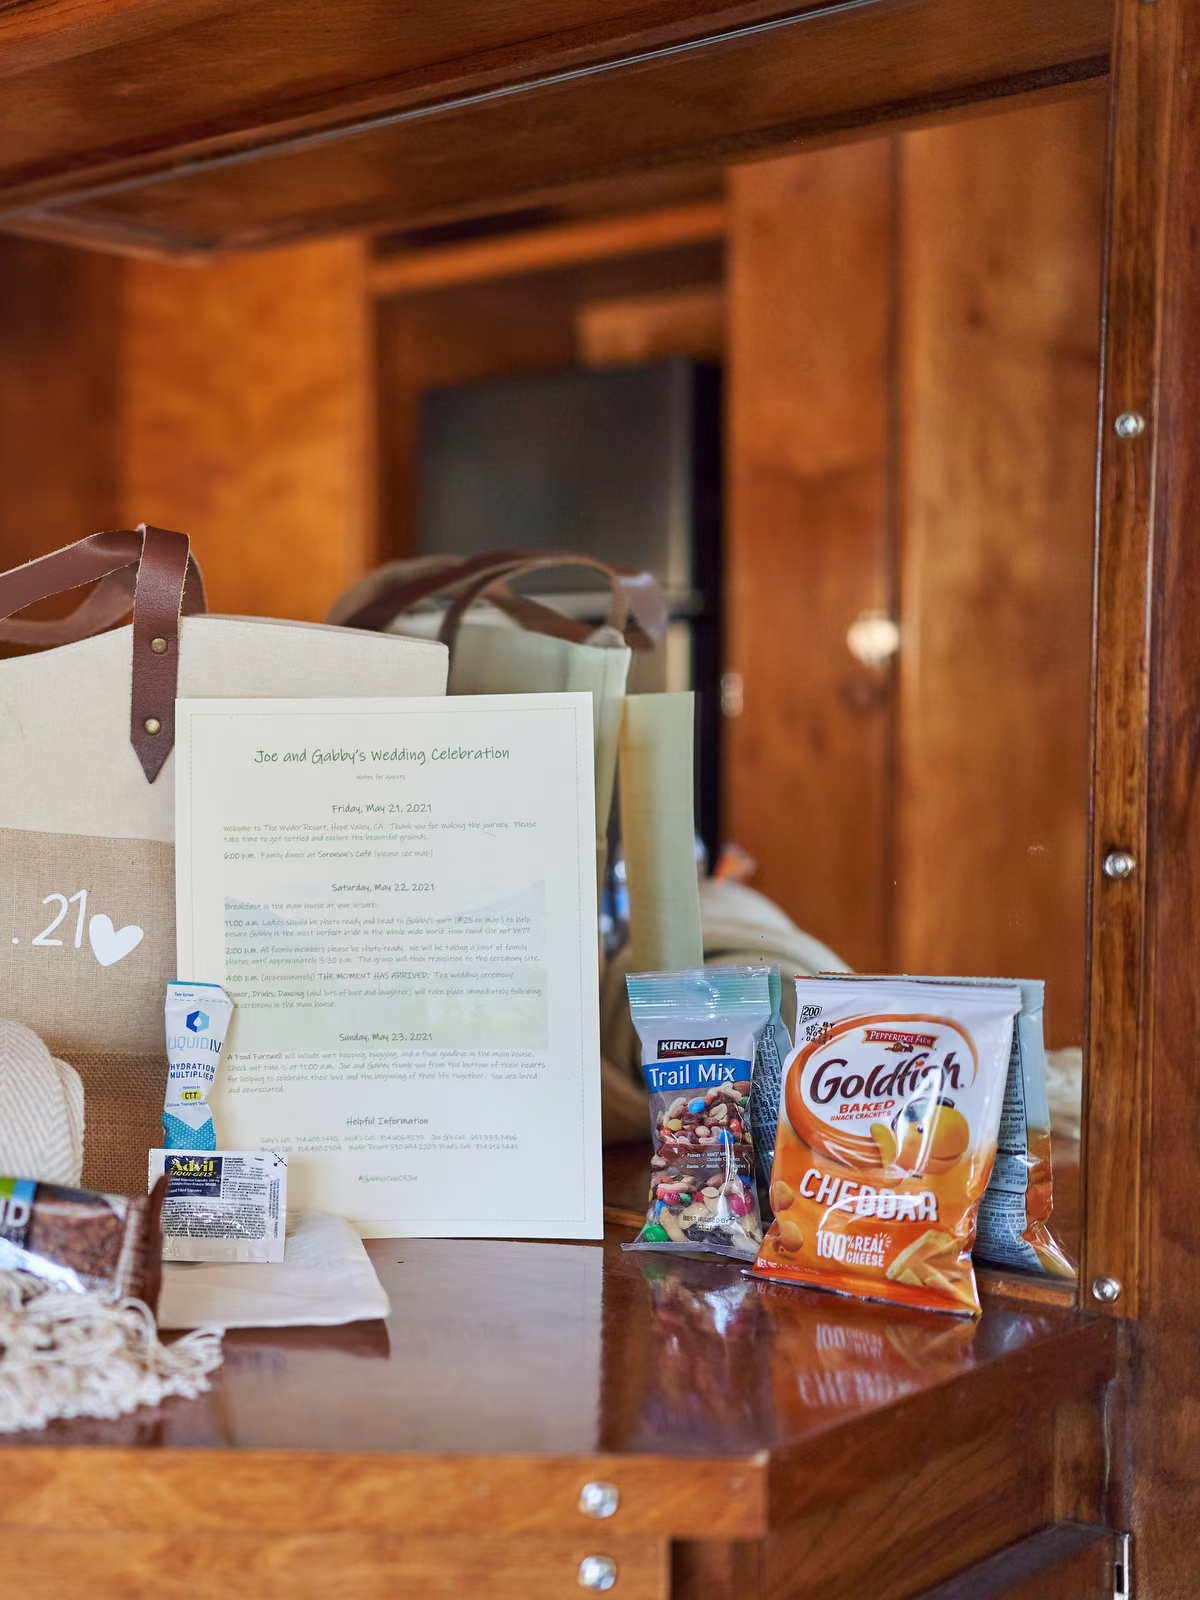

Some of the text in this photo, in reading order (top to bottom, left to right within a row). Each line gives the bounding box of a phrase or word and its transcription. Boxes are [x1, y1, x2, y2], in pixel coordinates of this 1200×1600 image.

[254, 747, 510, 765] Joe and Gabby's Wedding Celebration
[332, 803, 432, 814] Friday, May 21, 2021
[332, 883, 371, 892] Saturday,
[374, 883, 391, 892] May
[412, 883, 434, 892] 2021
[803, 1006, 820, 1016] 200
[339, 1033, 369, 1042] Sunday,
[372, 1033, 388, 1042] May
[410, 1032, 432, 1041] 2021
[661, 1040, 724, 1050] KIRKLAND
[170, 1063, 216, 1073] HYDRATION
[170, 1071, 214, 1082] MULTIPLIER
[649, 1064, 736, 1088] Trail Mix
[810, 1052, 959, 1104] Goldfish
[839, 1100, 896, 1114] BAKED
[346, 1116, 429, 1126] Helpful Information
[170, 1159, 214, 1171] Advil
[800, 1168, 938, 1222] CHEDDAR
[855, 1236, 885, 1254] REAL
[846, 1252, 884, 1267] CHEESE
